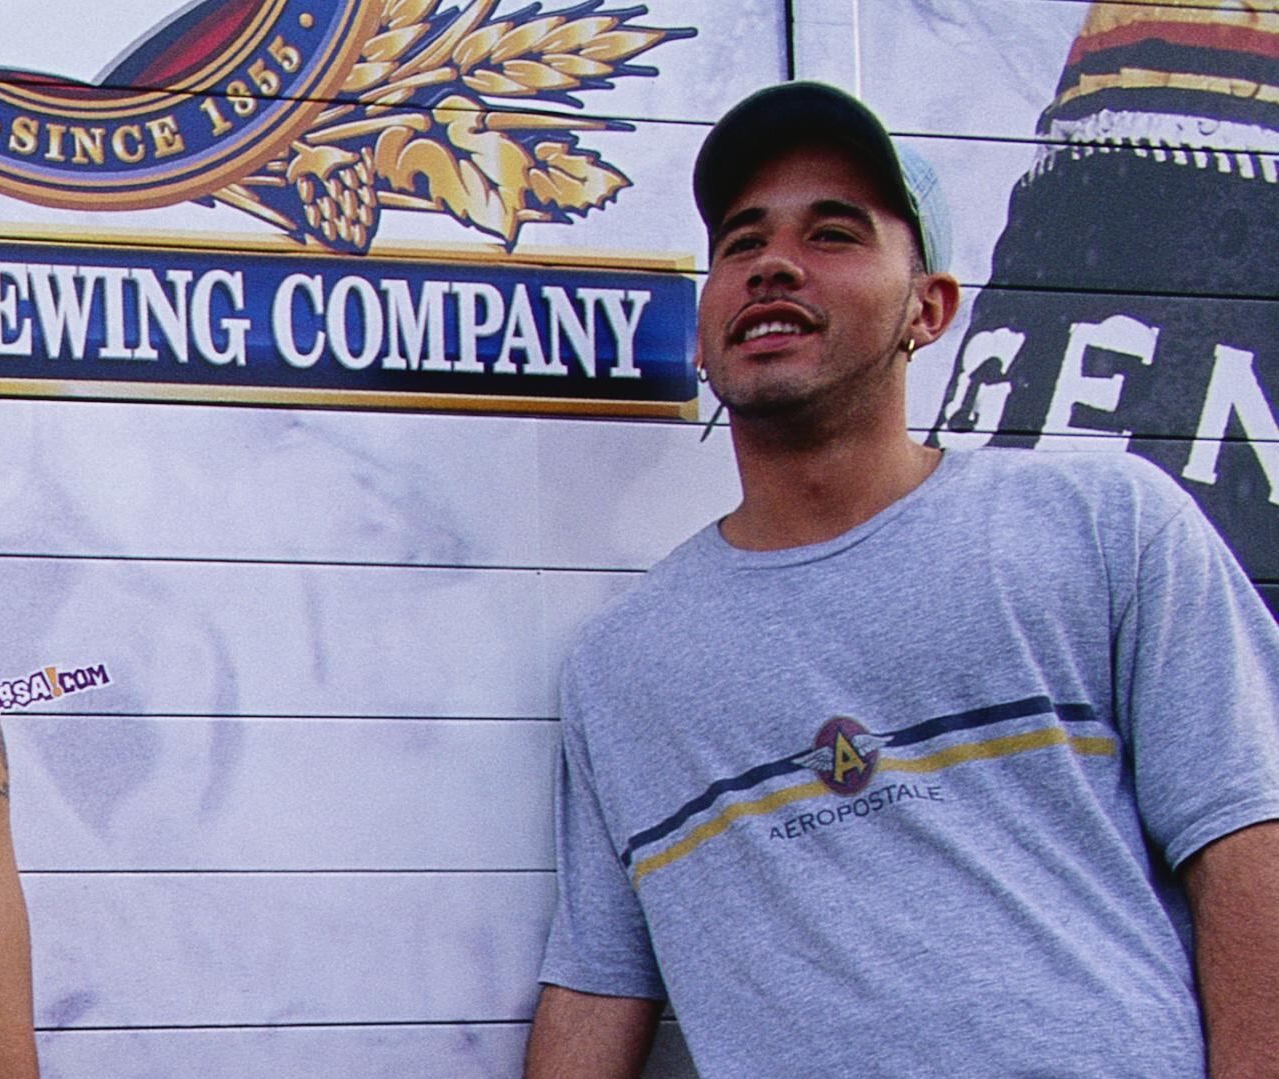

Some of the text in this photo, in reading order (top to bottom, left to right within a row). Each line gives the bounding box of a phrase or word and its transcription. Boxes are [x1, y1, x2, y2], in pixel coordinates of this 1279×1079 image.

[8, 34, 303, 165] SINCE 1855
[271, 272, 651, 379] COMPANY
